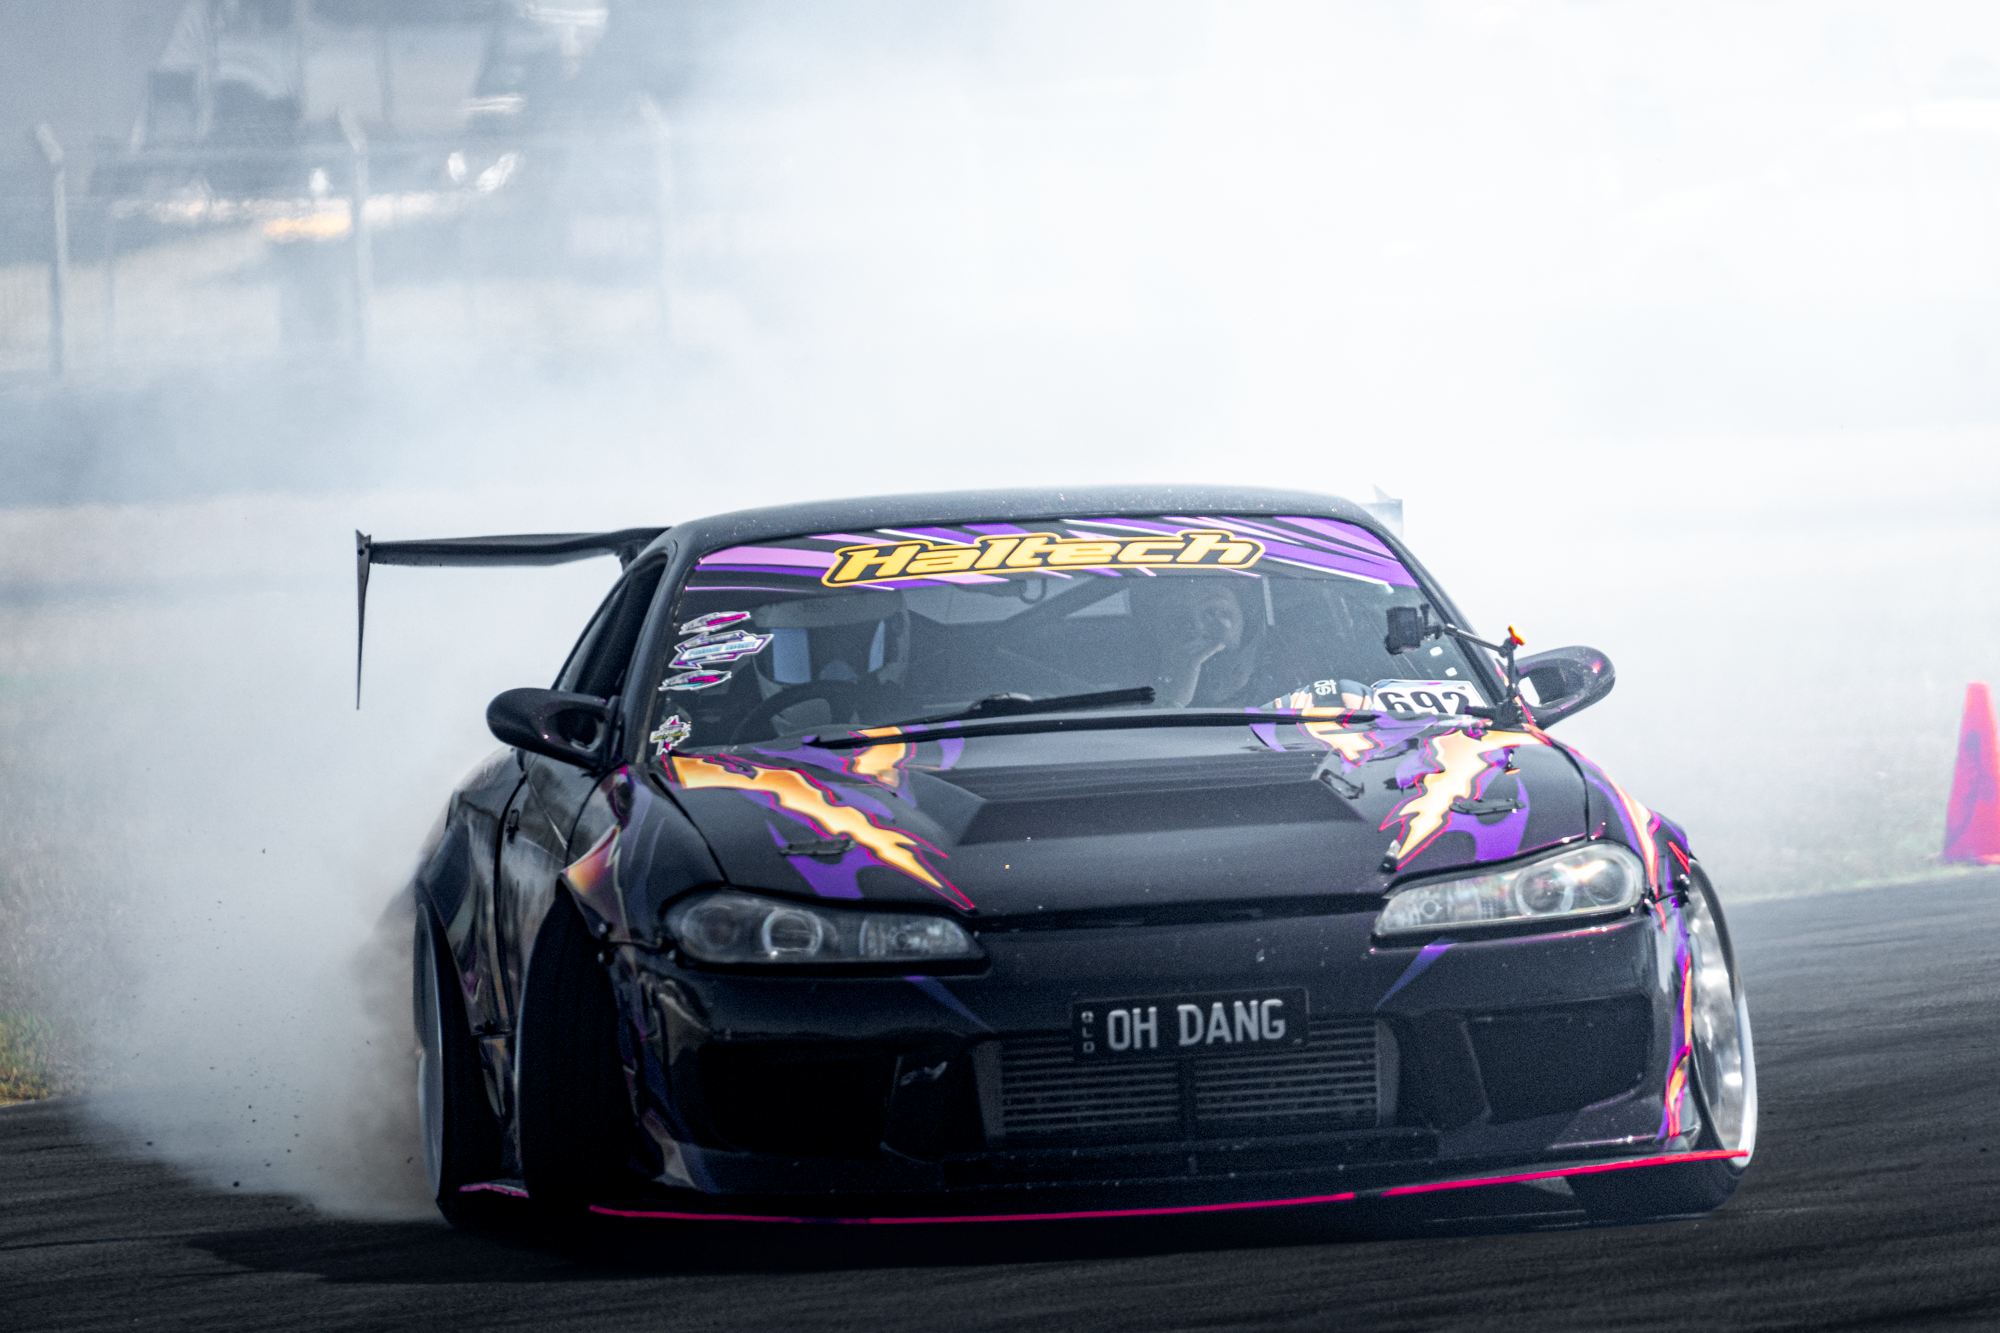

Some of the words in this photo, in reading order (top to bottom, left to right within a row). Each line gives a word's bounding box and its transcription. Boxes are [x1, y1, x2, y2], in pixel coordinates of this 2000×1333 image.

[832, 532, 1256, 583] Haltech
[1377, 690, 1470, 715] 692
[1080, 1010, 1096, 1054] QLD
[1106, 1006, 1158, 1051] OH
[1177, 998, 1287, 1047] DANG
